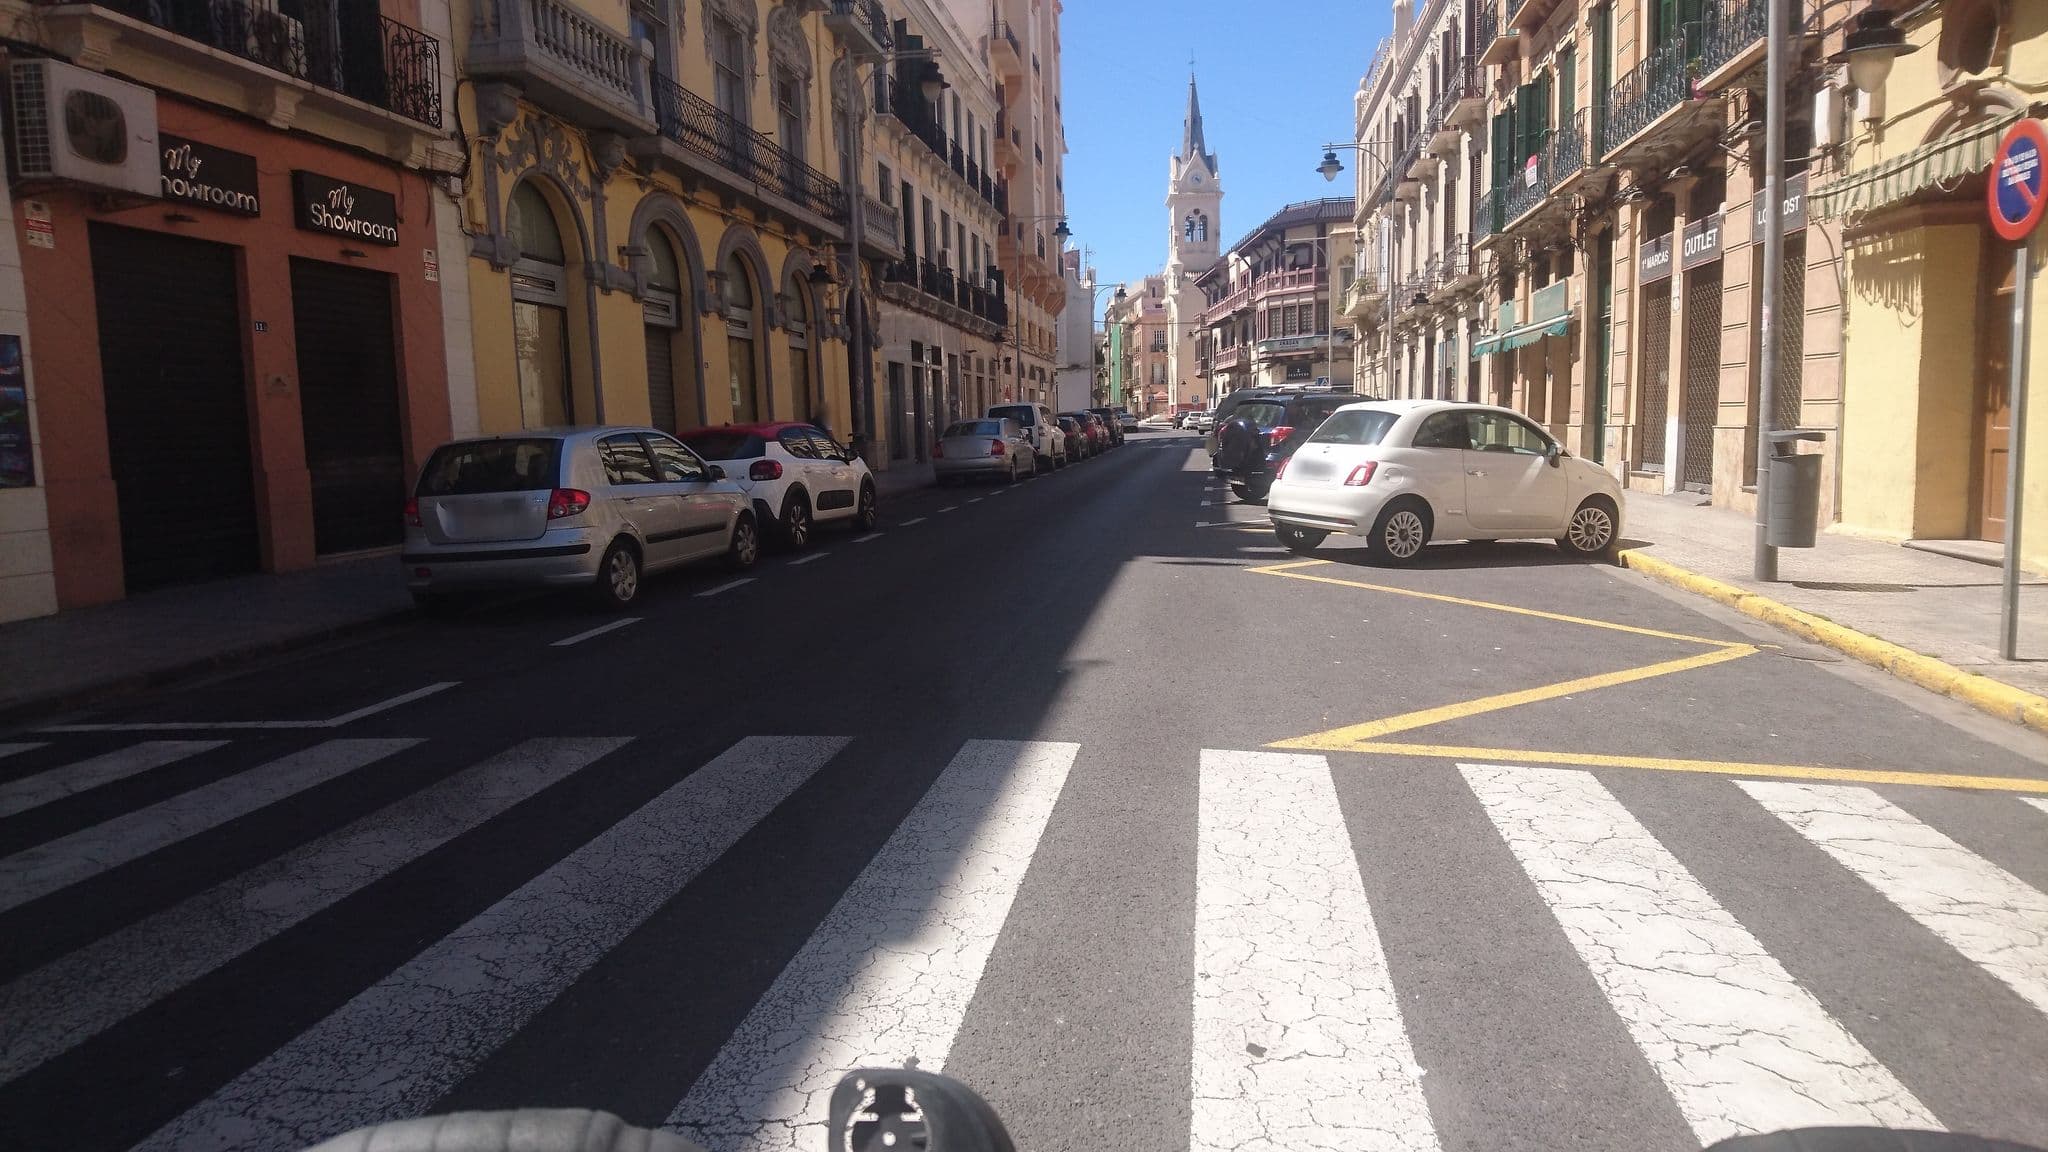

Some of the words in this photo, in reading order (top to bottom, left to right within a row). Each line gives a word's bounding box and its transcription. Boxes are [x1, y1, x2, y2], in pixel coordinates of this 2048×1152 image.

[165, 144, 202, 179] My
[160, 174, 258, 212] owroom
[328, 185, 355, 215] My
[1783, 195, 1800, 216] OST
[311, 203, 397, 242] Showroom
[1684, 228, 1718, 257] OUTLET
[1646, 249, 1670, 269] MARCAS
